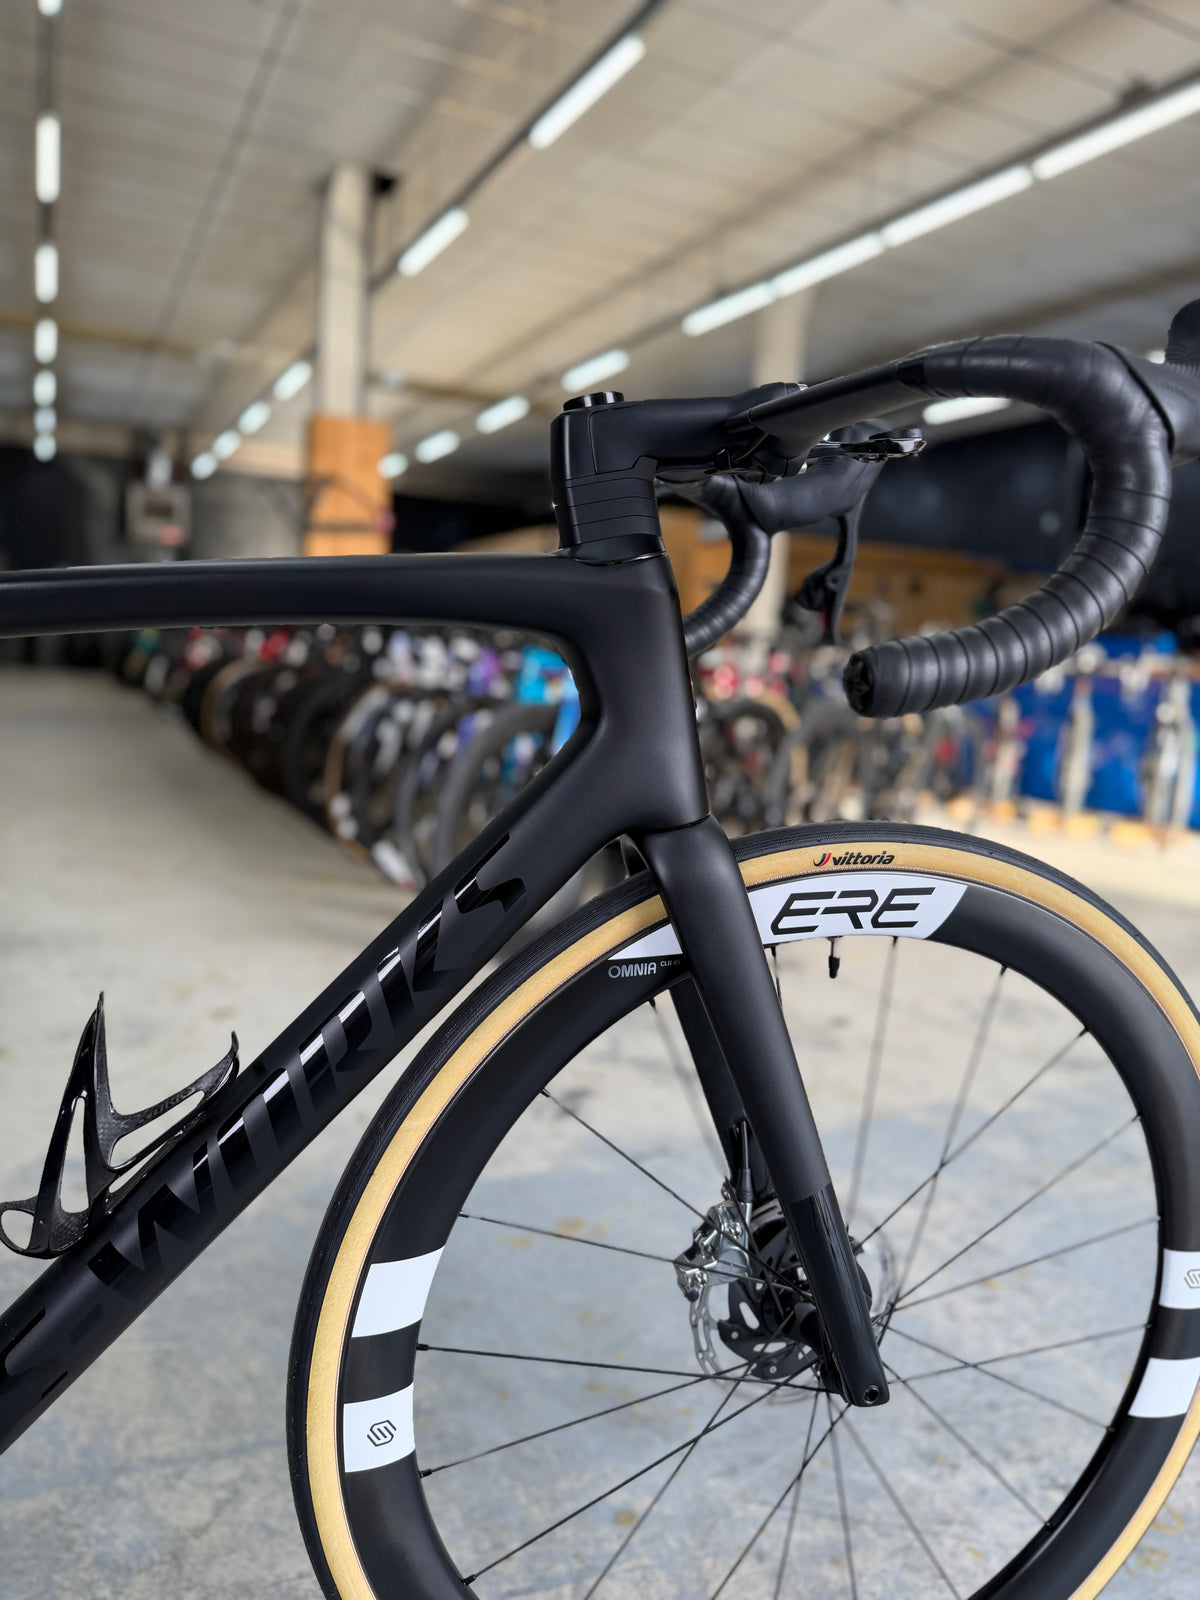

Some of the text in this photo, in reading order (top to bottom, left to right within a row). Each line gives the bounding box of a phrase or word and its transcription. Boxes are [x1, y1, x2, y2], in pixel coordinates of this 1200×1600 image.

[831, 850, 895, 866] vittoria
[770, 887, 936, 935] ERE
[607, 961, 657, 979] OMNIA
